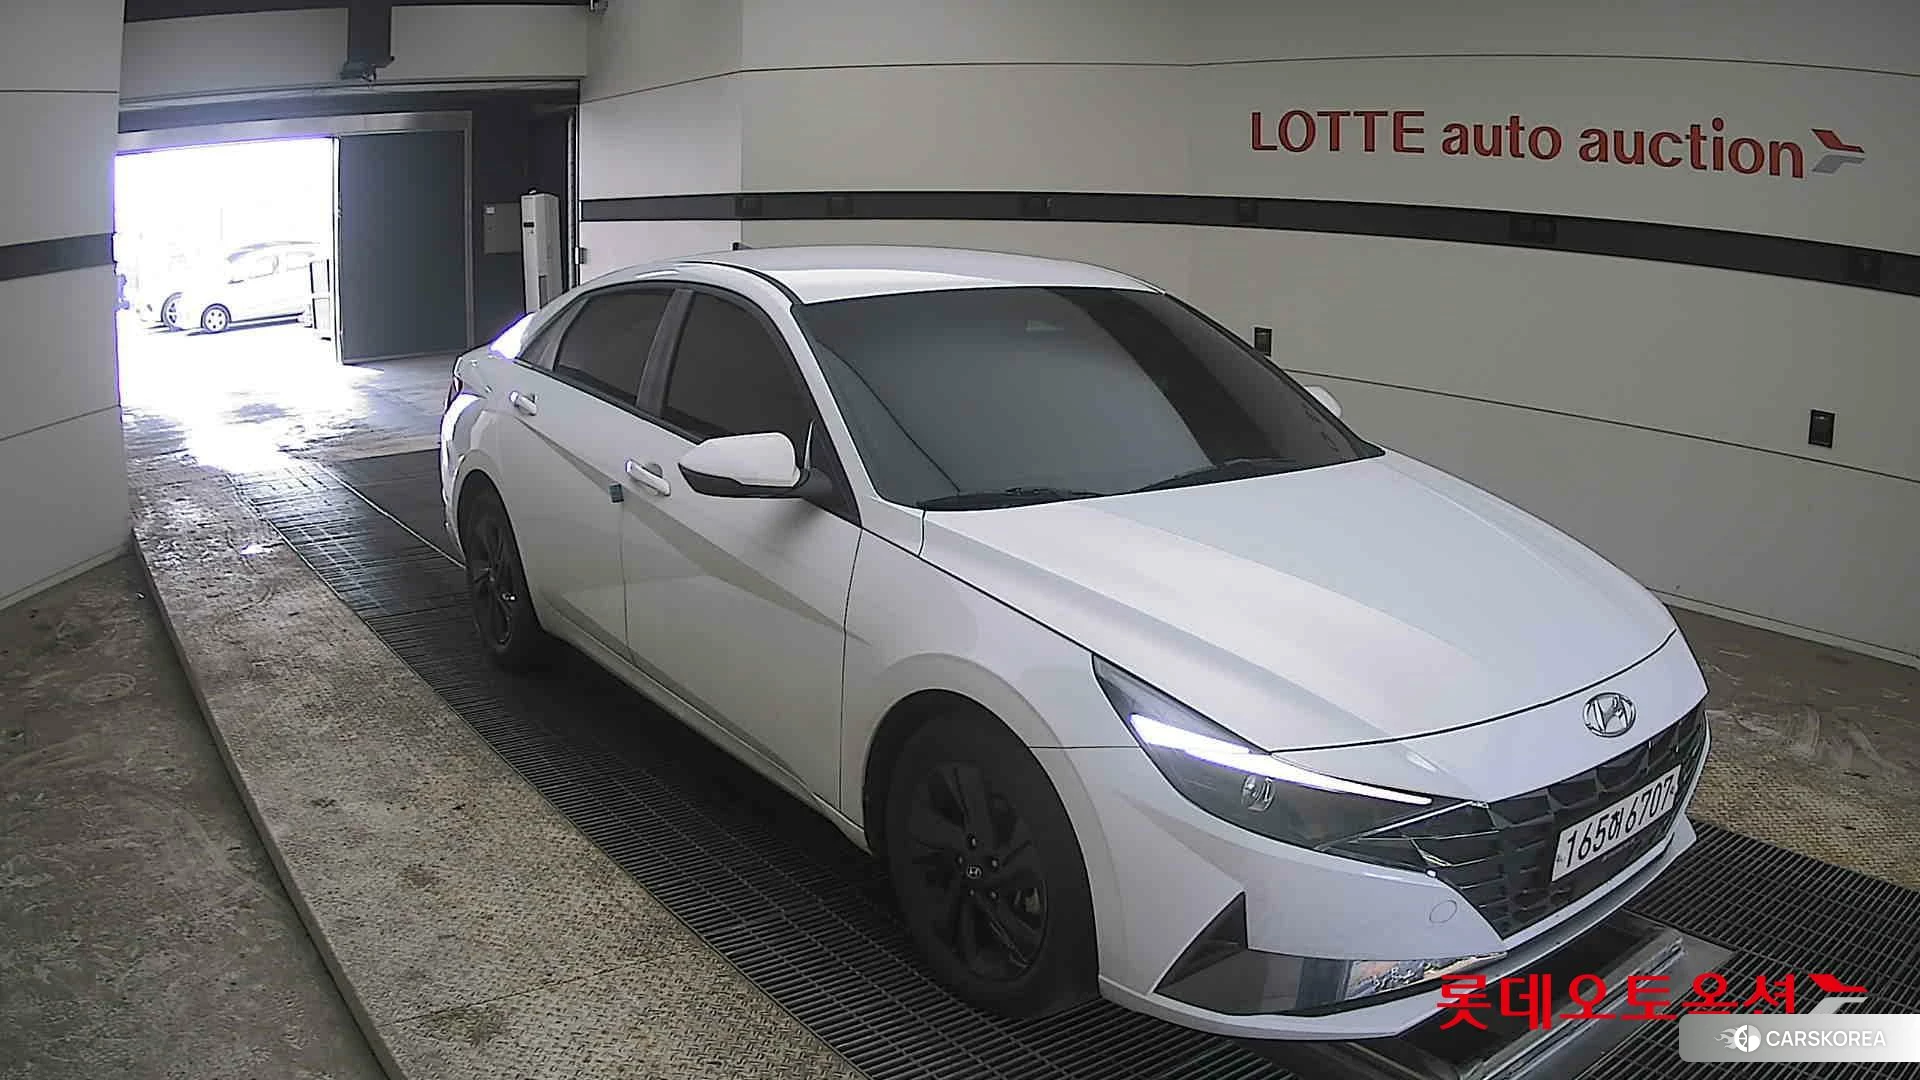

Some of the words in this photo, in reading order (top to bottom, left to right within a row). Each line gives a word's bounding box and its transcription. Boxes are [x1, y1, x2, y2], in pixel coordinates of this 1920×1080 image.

[1251, 110, 1425, 153] LOTTE
[1441, 115, 1562, 160] auto
[1578, 117, 1805, 179] auction
